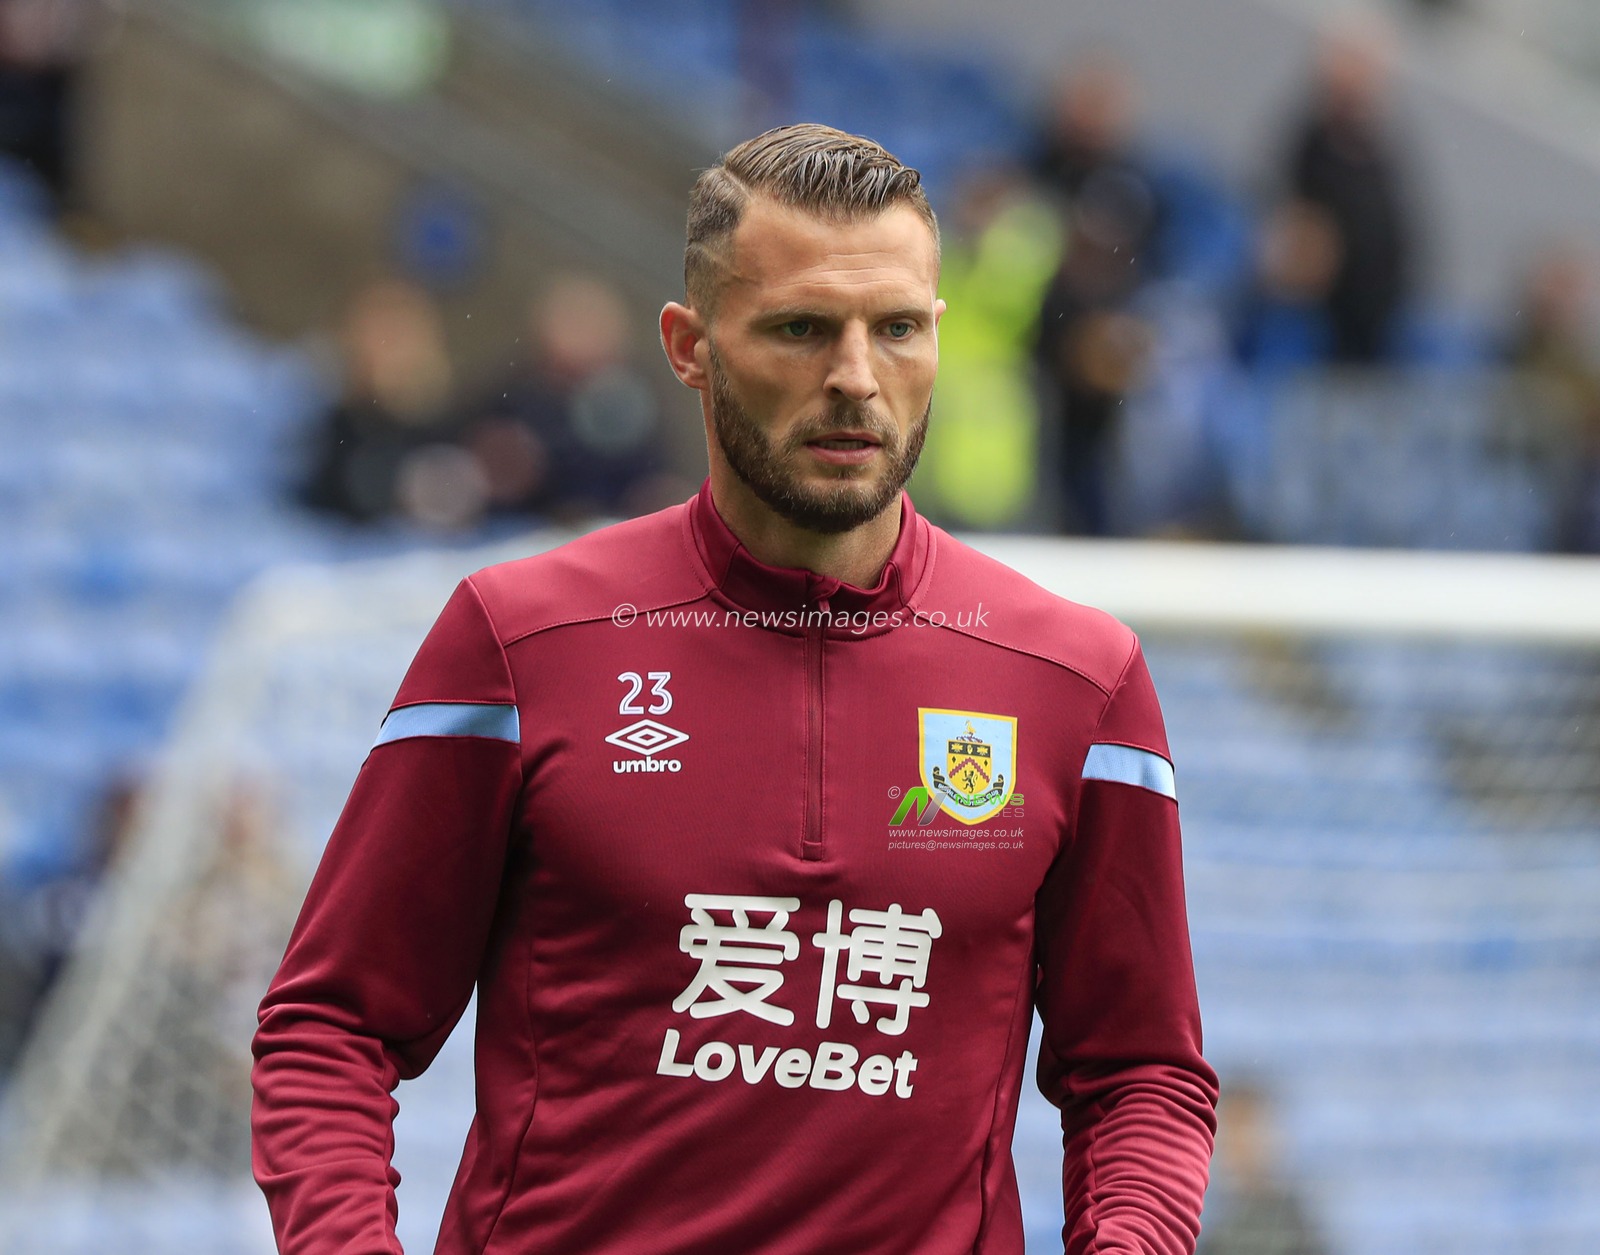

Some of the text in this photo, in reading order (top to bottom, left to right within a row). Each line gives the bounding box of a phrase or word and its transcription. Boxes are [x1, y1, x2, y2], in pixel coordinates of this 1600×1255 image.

[617, 671, 673, 715] 23
[613, 756, 681, 773] umbro
[672, 893, 943, 1036] 爱博
[656, 1028, 918, 1099] LoveBet
